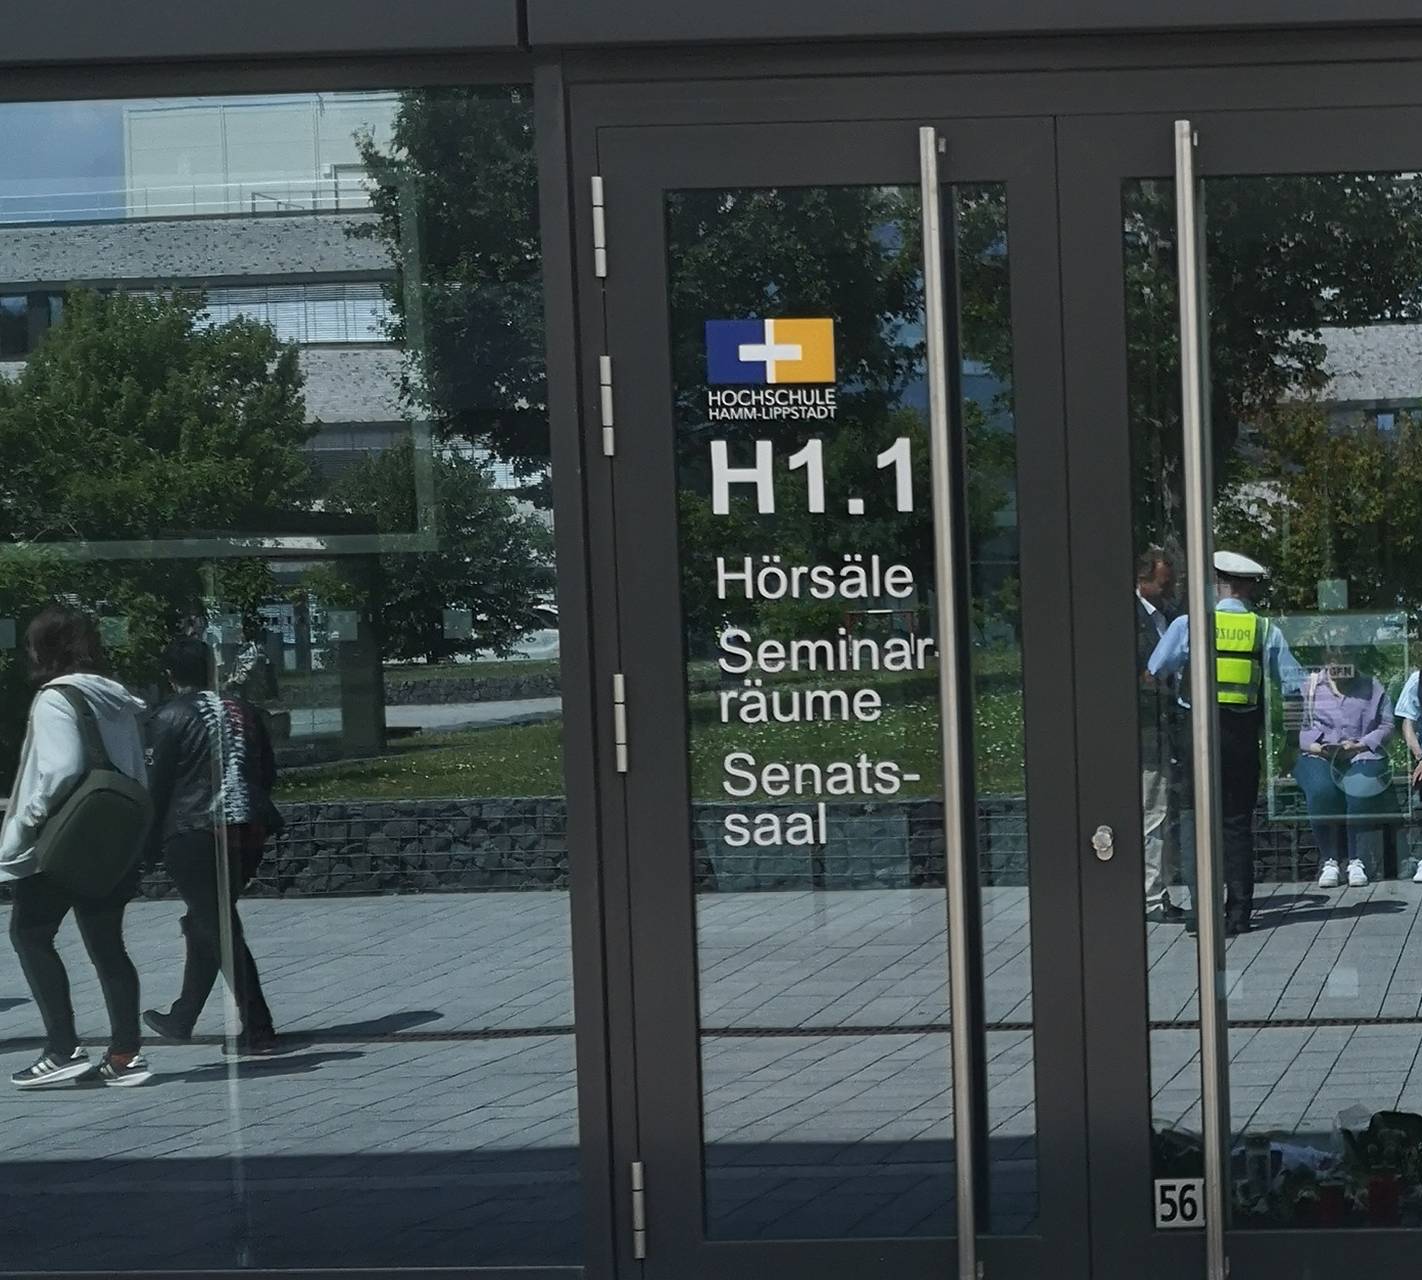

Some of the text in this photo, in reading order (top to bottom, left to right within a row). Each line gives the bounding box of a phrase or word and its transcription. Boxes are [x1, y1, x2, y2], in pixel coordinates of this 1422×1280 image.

[708, 389, 836, 406] HOCHSCHULE
[708, 406, 837, 421] HAMM-LIPPSTADT
[710, 437, 913, 515] H1.1
[716, 554, 914, 600] Hörsäle
[720, 679, 882, 723] räume
[723, 752, 921, 796] Senats-
[724, 802, 827, 846] saal
[1160, 1184, 1197, 1222] 56
